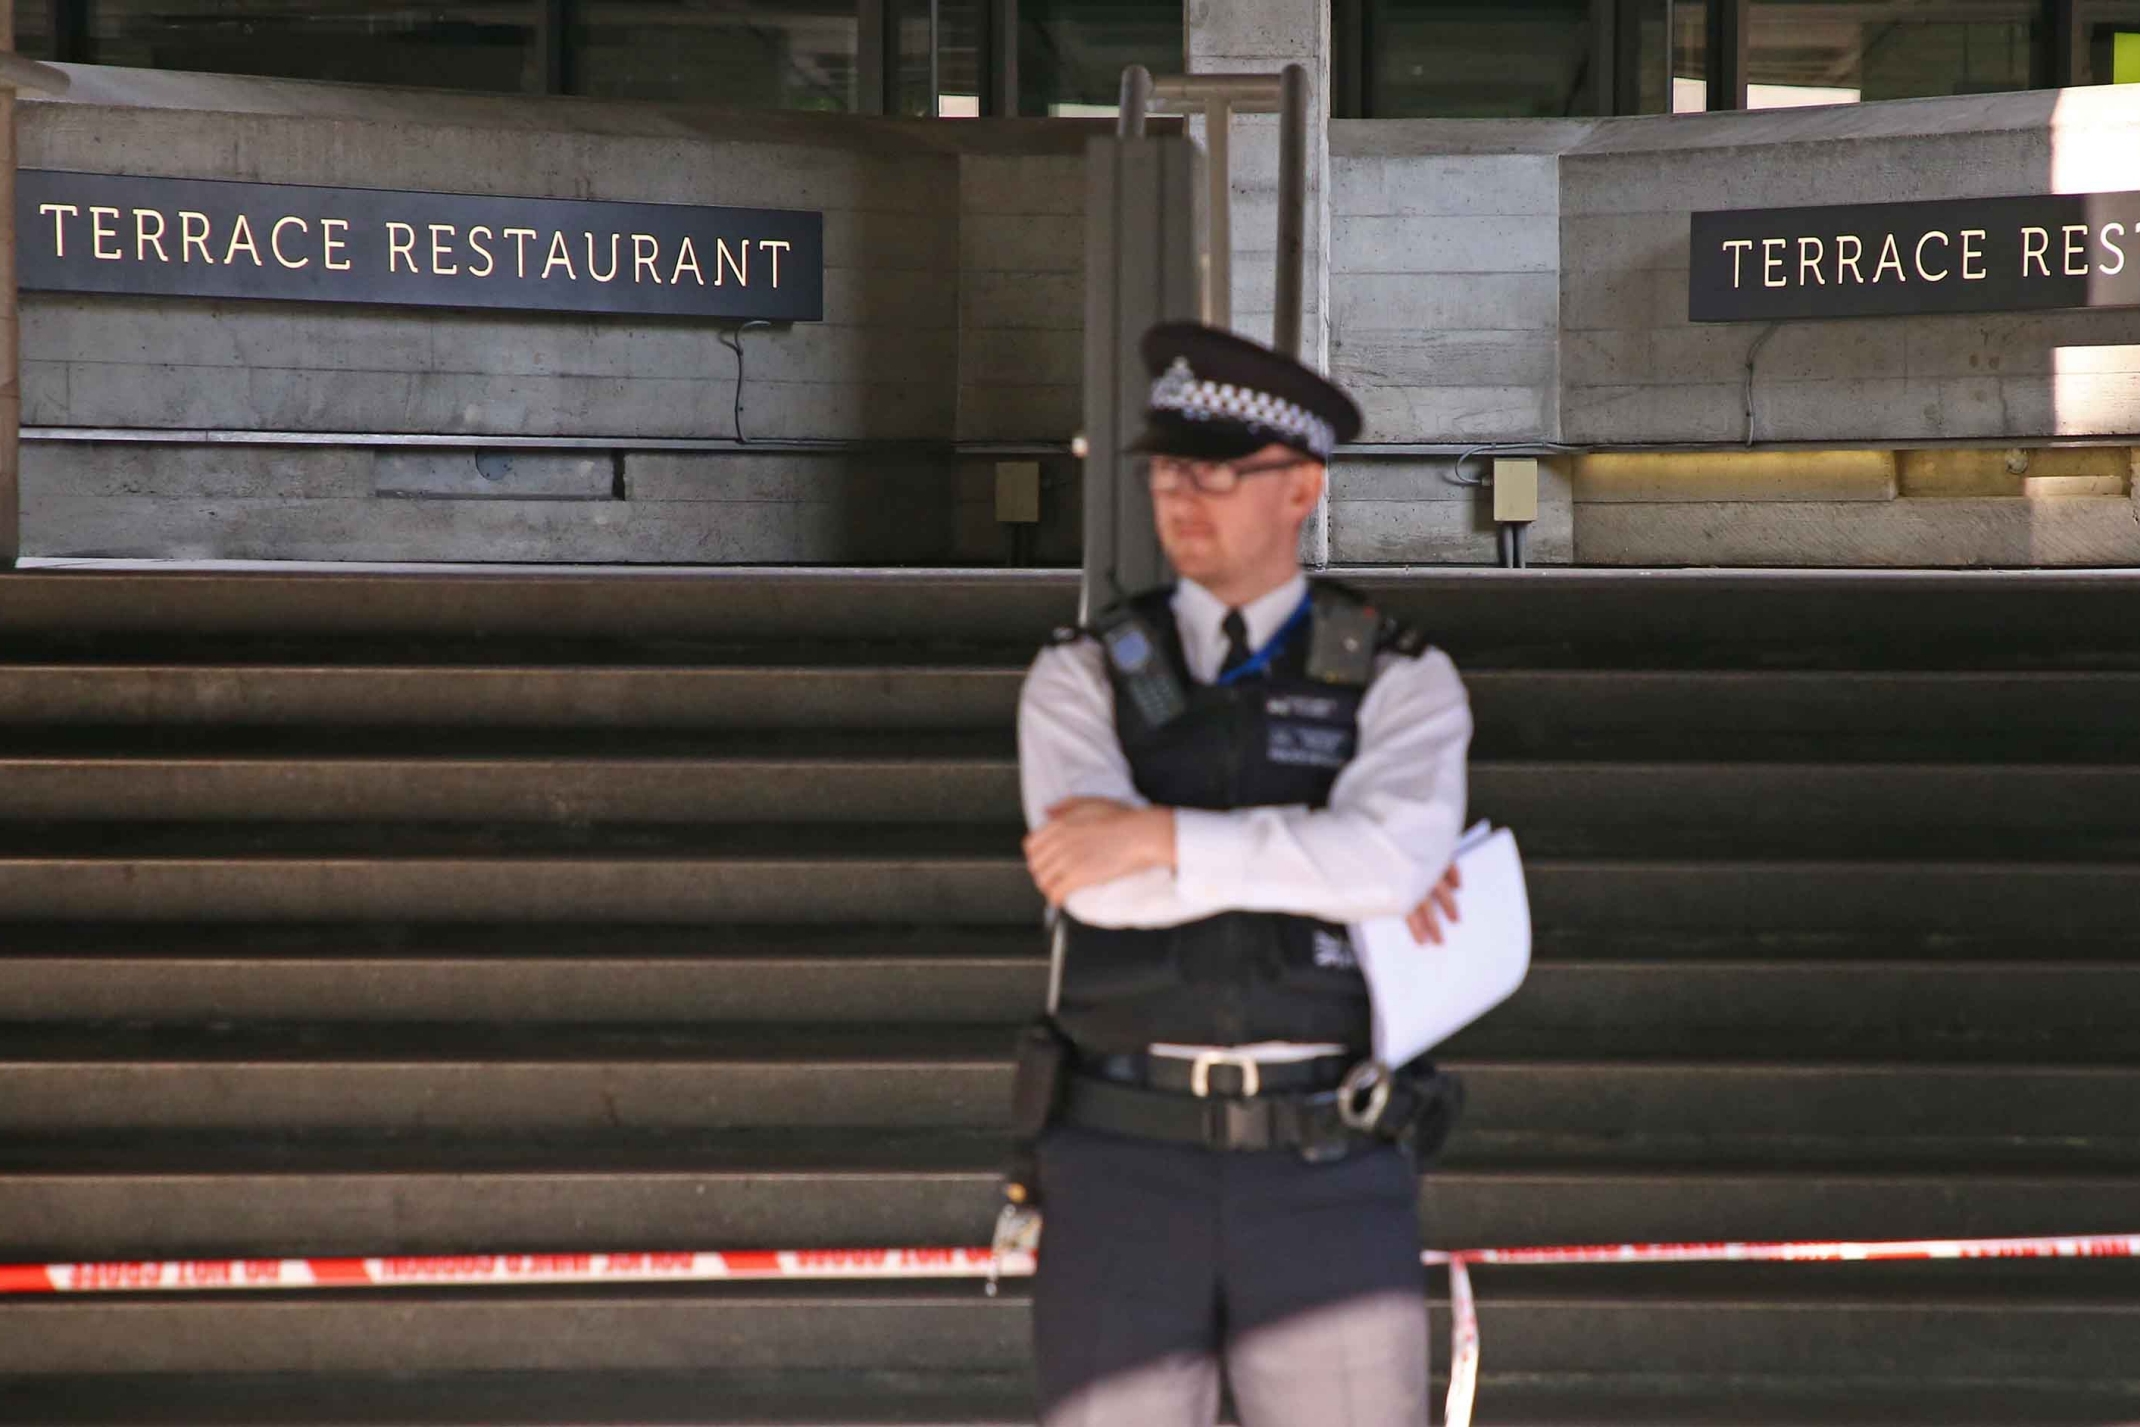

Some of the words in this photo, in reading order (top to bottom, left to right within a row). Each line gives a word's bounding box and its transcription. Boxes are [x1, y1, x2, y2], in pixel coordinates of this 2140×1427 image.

[39, 203, 352, 271] TERRACE
[385, 221, 791, 289] RESTAURANT
[1722, 230, 1987, 288] TERRACE
[2020, 222, 2140, 278] RES
